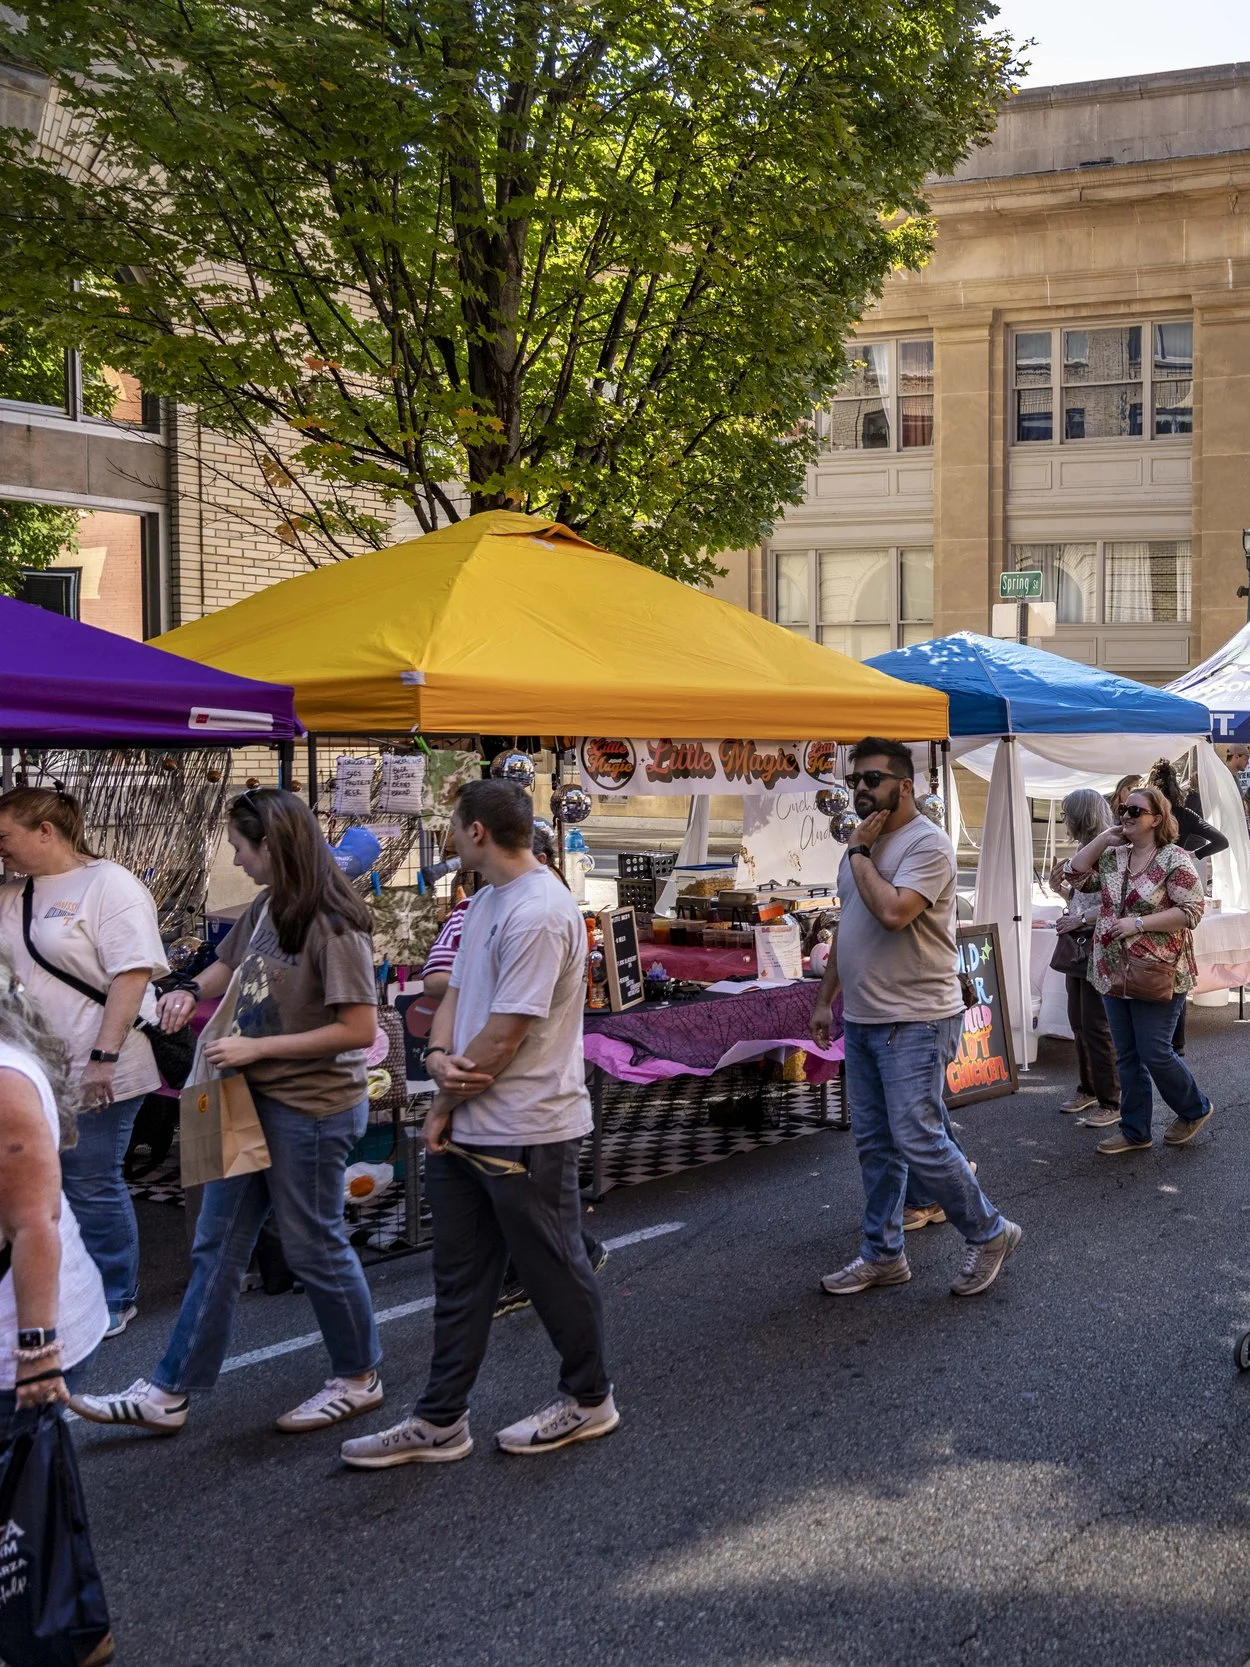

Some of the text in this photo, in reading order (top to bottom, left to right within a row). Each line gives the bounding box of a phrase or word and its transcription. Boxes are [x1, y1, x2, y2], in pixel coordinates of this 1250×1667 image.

[1002, 575, 1029, 594] Spring
[587, 738, 628, 756] Little
[587, 754, 635, 777] Magic
[645, 738, 799, 786] Little Magic
[946, 1056, 1009, 1094] CHICKEN
